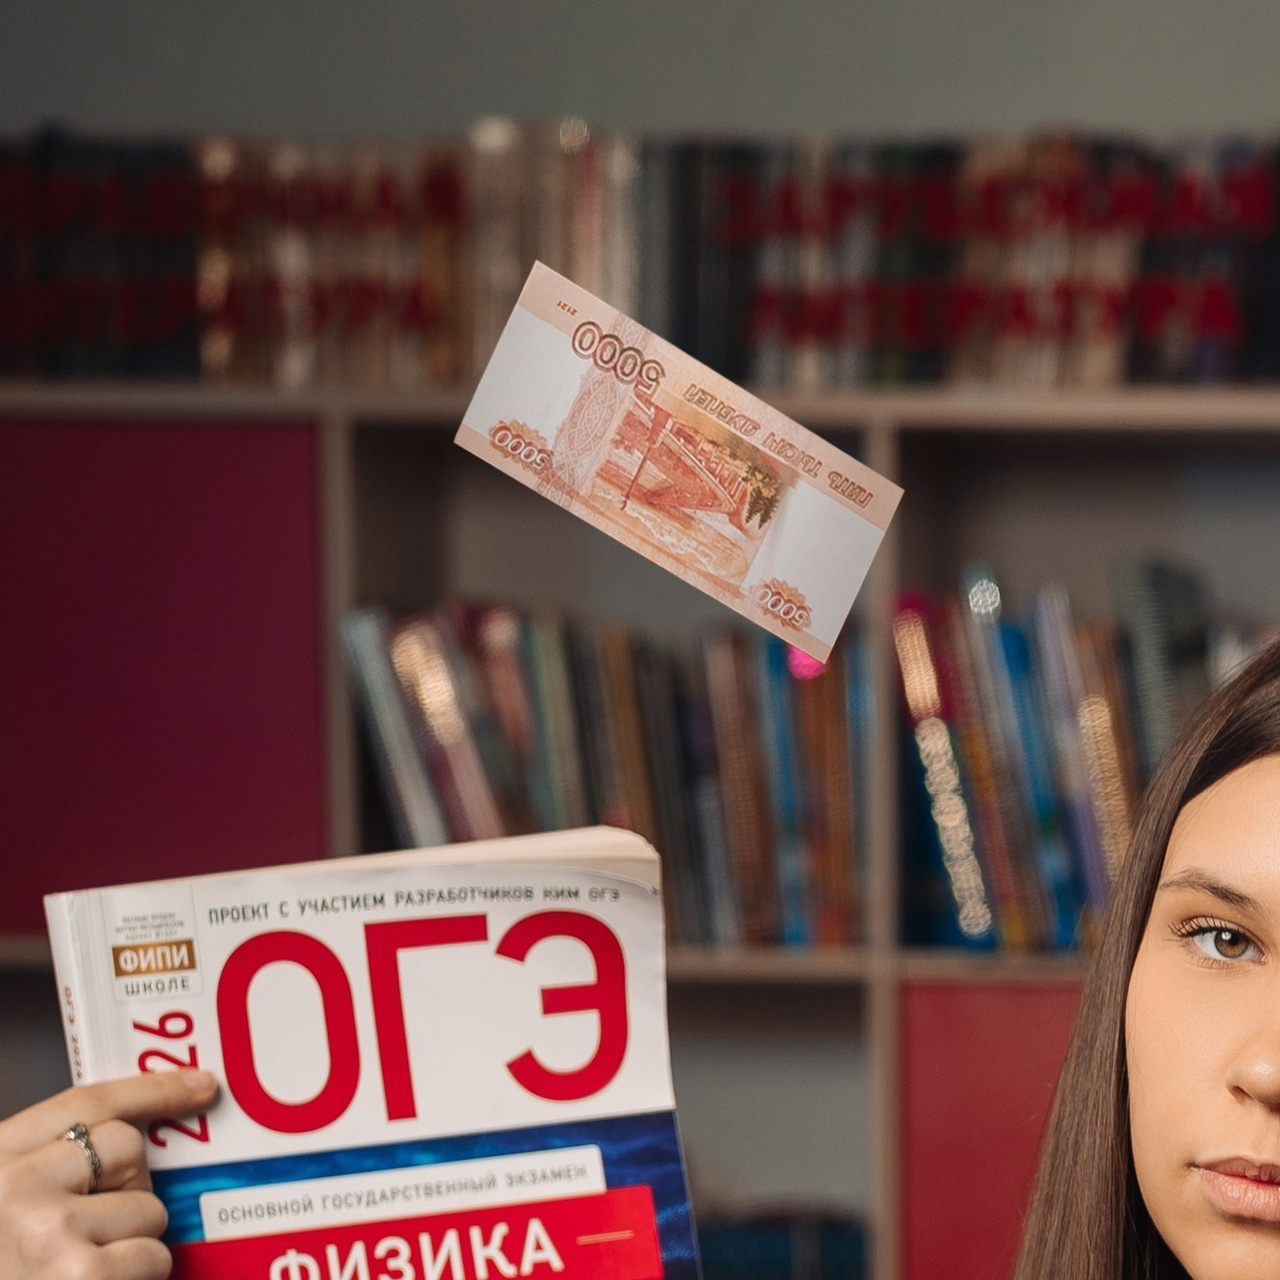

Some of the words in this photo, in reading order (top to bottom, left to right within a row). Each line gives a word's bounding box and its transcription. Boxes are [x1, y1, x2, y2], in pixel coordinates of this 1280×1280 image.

[571, 320, 666, 394] 5000
[493, 425, 554, 471] 5000
[757, 586, 811, 628] 5000
[208, 902, 270, 925] ПРОЕКТ
[280, 901, 290, 918] С
[298, 892, 386, 917] УЧАСТИЕМ
[395, 886, 534, 908] РАЗРАБОТЧИКОВ
[118, 943, 190, 973] ФИПИ
[125, 976, 191, 997] ШКОЛЕ
[215, 910, 628, 1134] ОГЭ
[132, 1010, 210, 1148] 226
[218, 1195, 315, 1224] ОСНОВНОЙ
[321, 1173, 497, 1214] ГОСУДАРСТВЕННЫЙ
[504, 1164, 588, 1191] ЭКЗАМЕН
